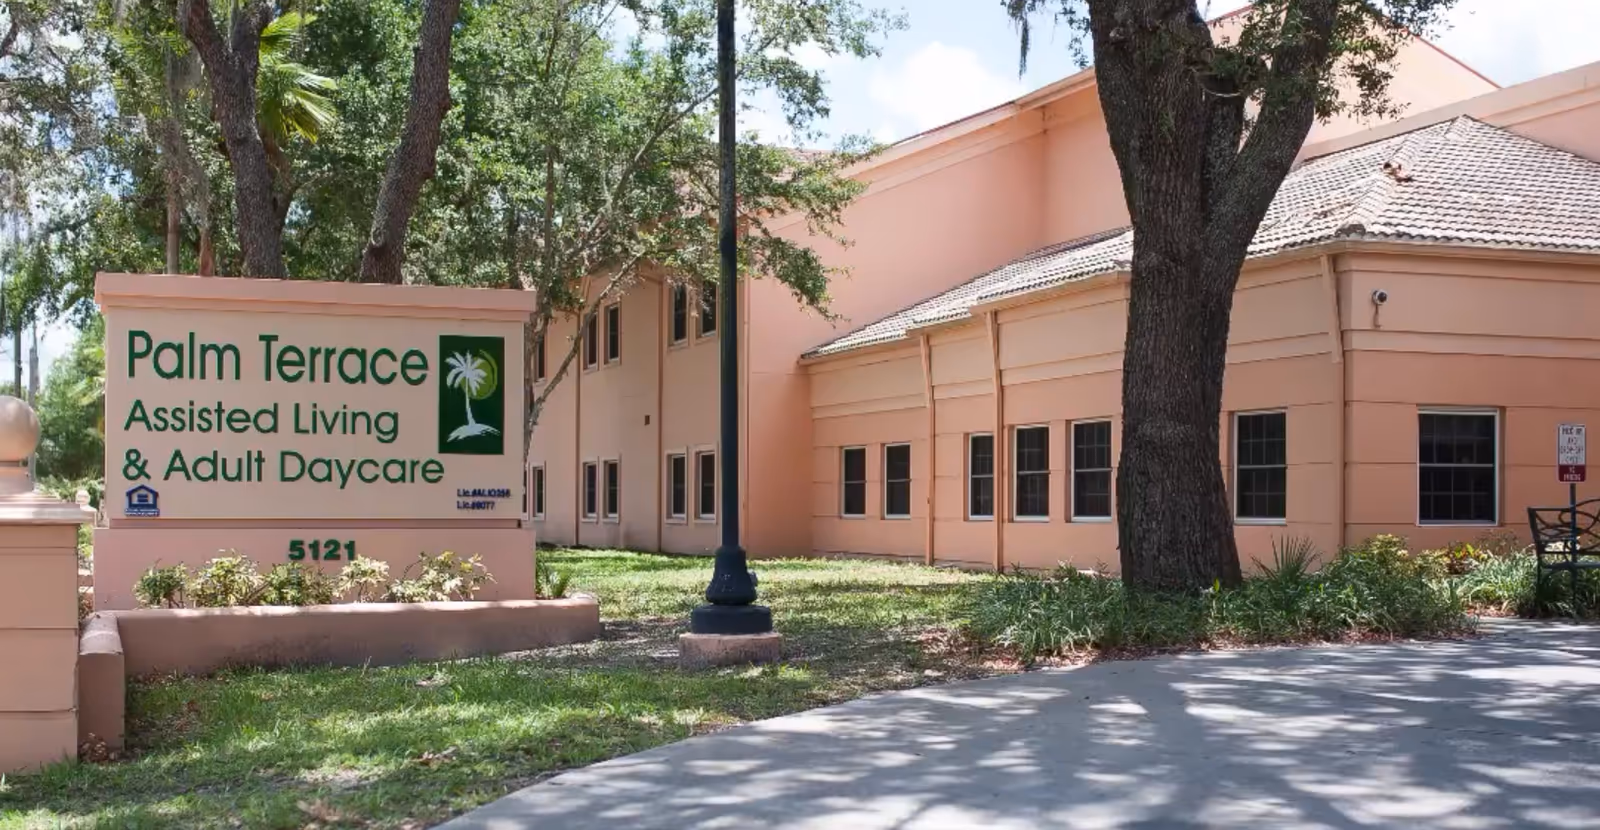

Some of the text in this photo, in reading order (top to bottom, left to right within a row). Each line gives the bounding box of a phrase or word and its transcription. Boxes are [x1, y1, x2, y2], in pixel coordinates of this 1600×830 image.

[128, 330, 430, 386] Palm Terrace
[124, 400, 399, 443] Assisted Living
[123, 449, 445, 489] & Adult Daycare
[288, 539, 356, 561] 5121
